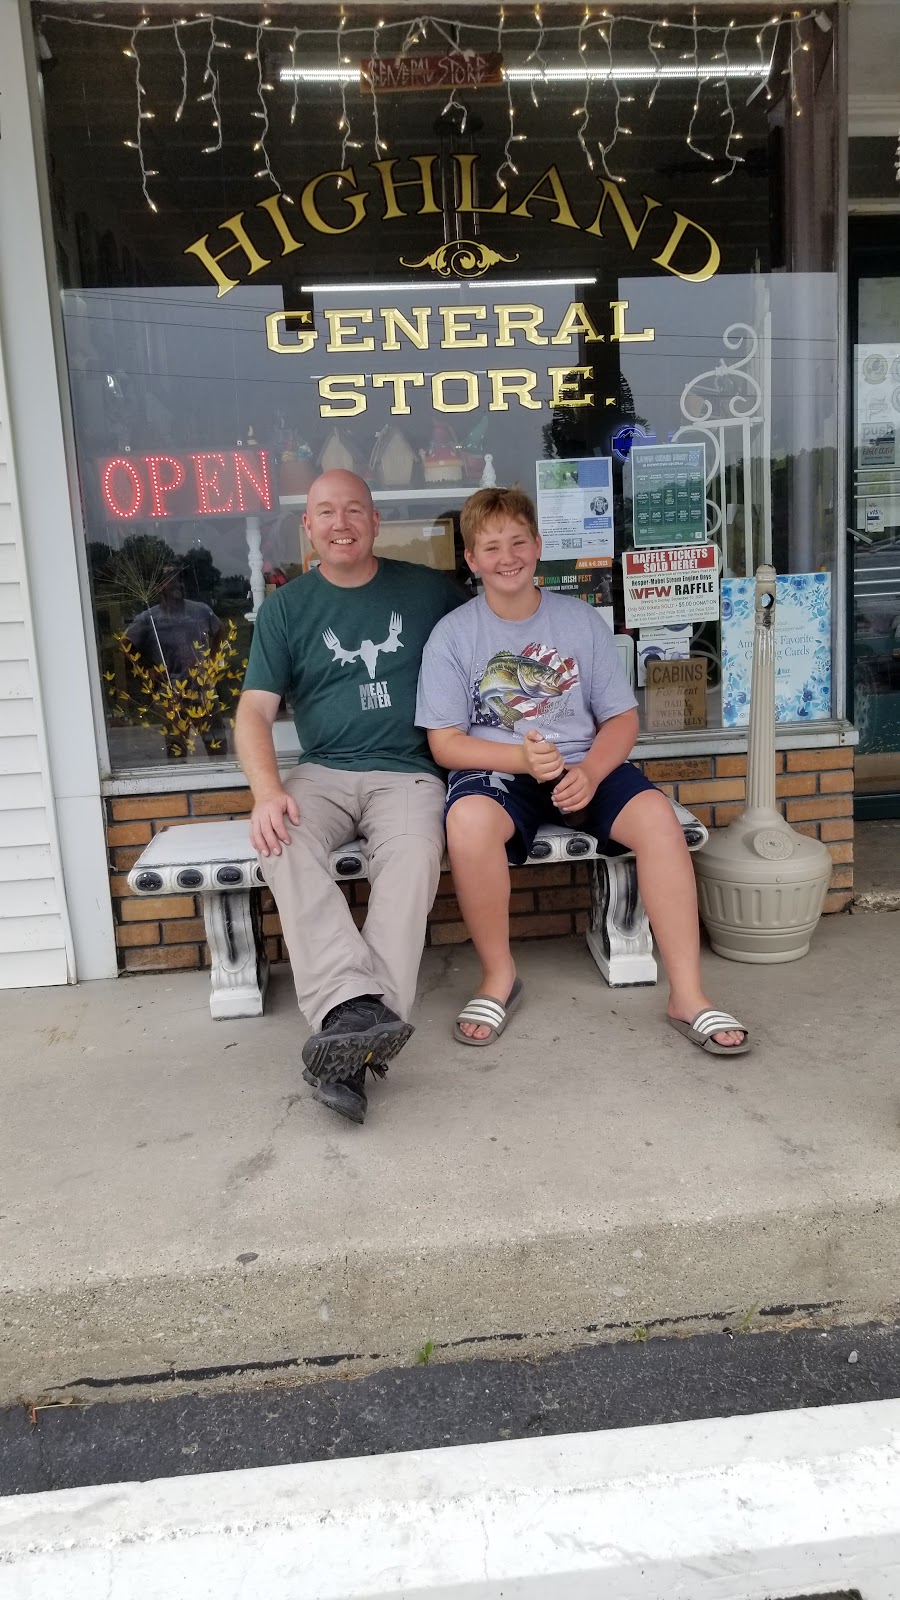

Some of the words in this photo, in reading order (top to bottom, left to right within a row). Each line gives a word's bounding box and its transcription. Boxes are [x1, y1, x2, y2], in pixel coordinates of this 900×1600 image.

[183, 153, 721, 298] HIGHLAND
[264, 300, 656, 354] GENERAL
[103, 450, 271, 518] OPEN
[632, 552, 666, 564] RAFFLE
[668, 548, 708, 561] TICKETS
[643, 561, 668, 573] SOLD
[670, 559, 698, 570] HERE!
[561, 575, 577, 583] IRISH
[578, 574, 592, 582] FEST
[682, 575, 699, 583] Engine
[629, 585, 672, 600] VFW
[675, 582, 714, 596] RAFFLE
[780, 634, 814, 645] Favorite
[784, 645, 810, 657] Cards
[652, 664, 703, 684] CABINS
[359, 681, 388, 697] MEAT
[361, 693, 392, 710] EATER
[664, 699, 689, 708] DAILY
[660, 708, 693, 718] WEEKLY
[652, 717, 703, 728] SEASONALLY
